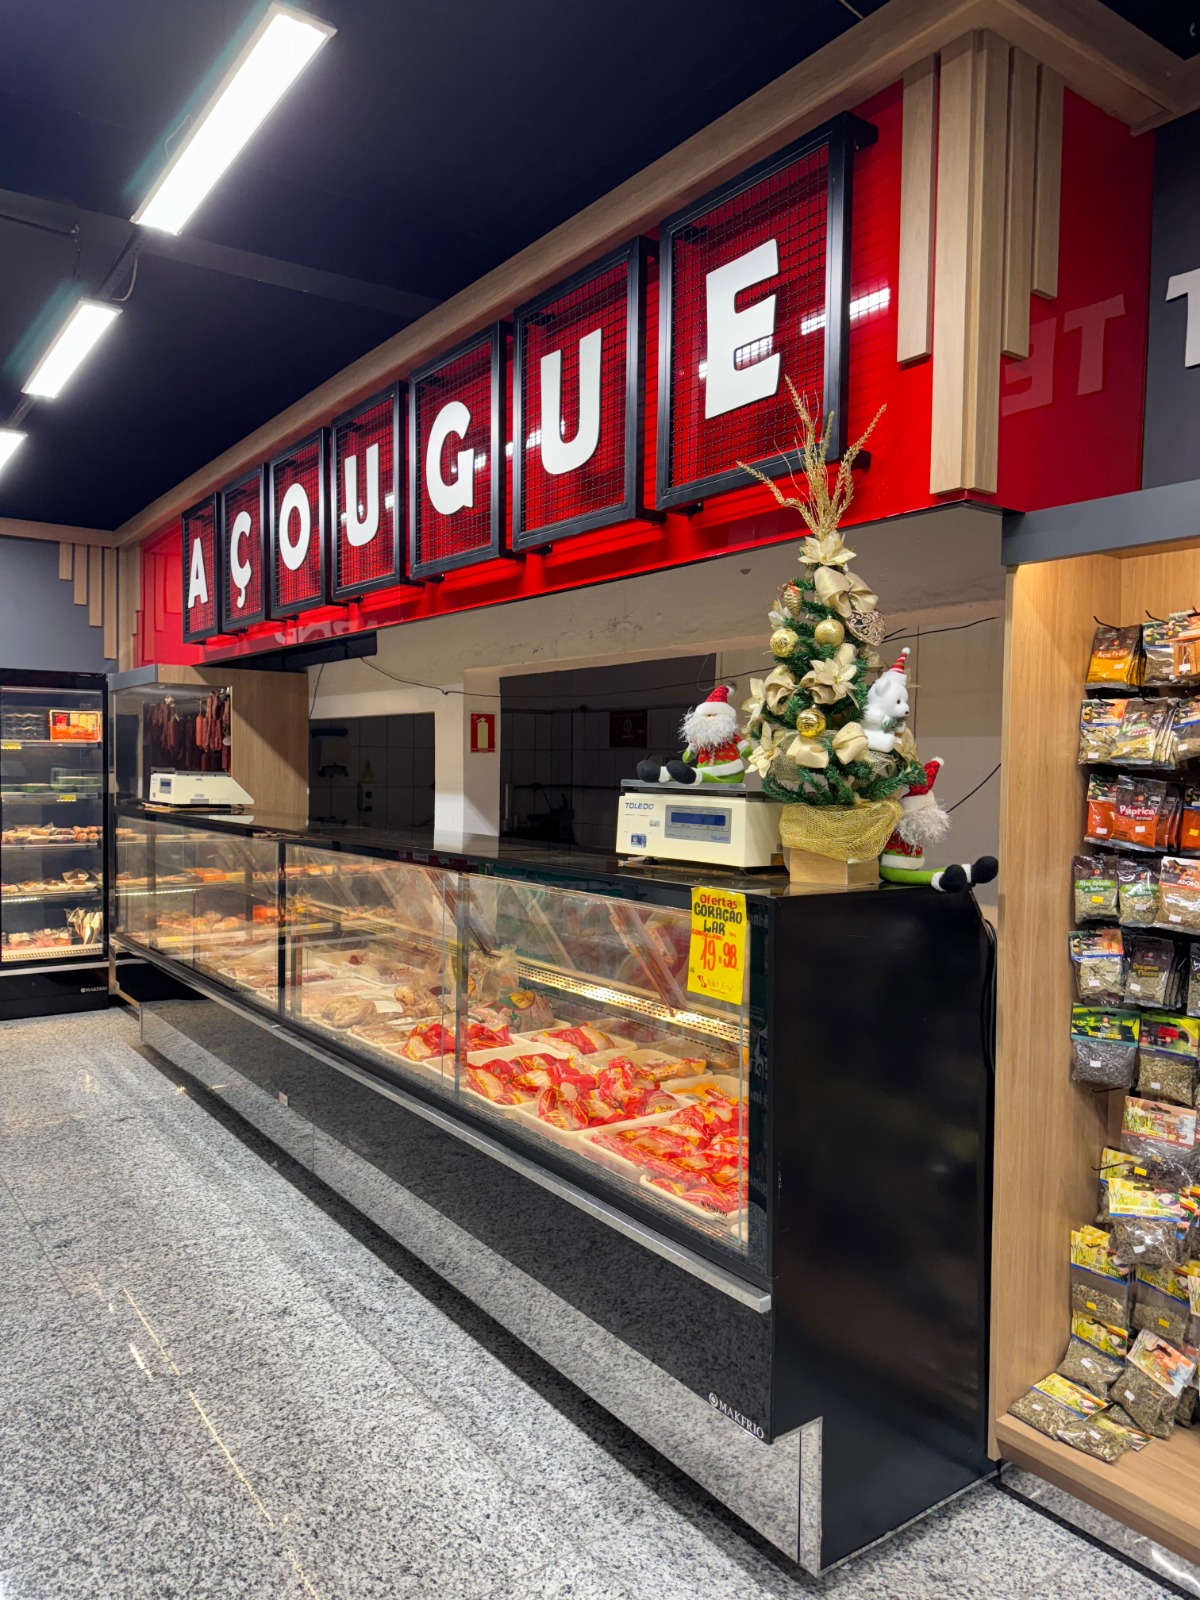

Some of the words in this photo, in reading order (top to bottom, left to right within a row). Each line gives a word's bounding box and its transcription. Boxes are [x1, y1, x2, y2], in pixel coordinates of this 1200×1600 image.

[187, 238, 781, 609] AÇOUGUE
[625, 802, 654, 810] TOLEDO
[1119, 805, 1156, 817] Páprica
[699, 893, 738, 909] Ofertas
[694, 902, 743, 924] CORAÇÃO
[703, 919, 726, 936] LAR
[718, 1399, 765, 1439] MAKFRIO
